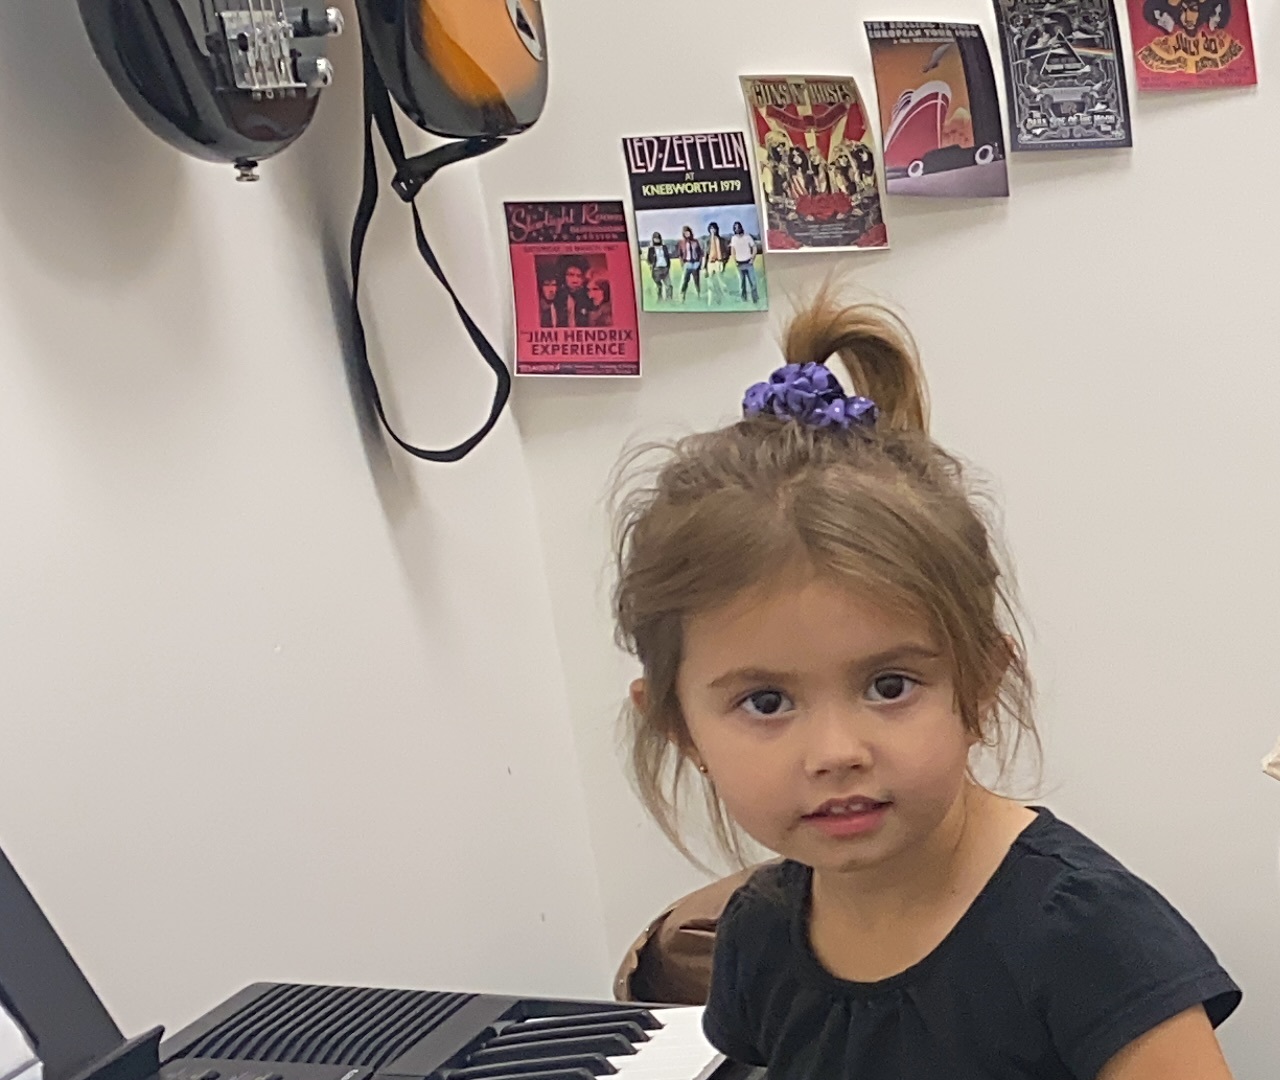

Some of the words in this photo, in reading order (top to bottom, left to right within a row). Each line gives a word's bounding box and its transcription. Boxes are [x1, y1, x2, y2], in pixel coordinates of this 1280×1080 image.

[868, 29, 921, 38] EUROPEAN
[924, 29, 953, 38] TOUR
[685, 172, 695, 180] AT
[642, 181, 717, 196] KNEBWORTH
[720, 180, 741, 191] 1979
[527, 330, 558, 343] JIMI
[563, 329, 633, 341] HENDRIX
[531, 343, 625, 355] EXPERIENCE
